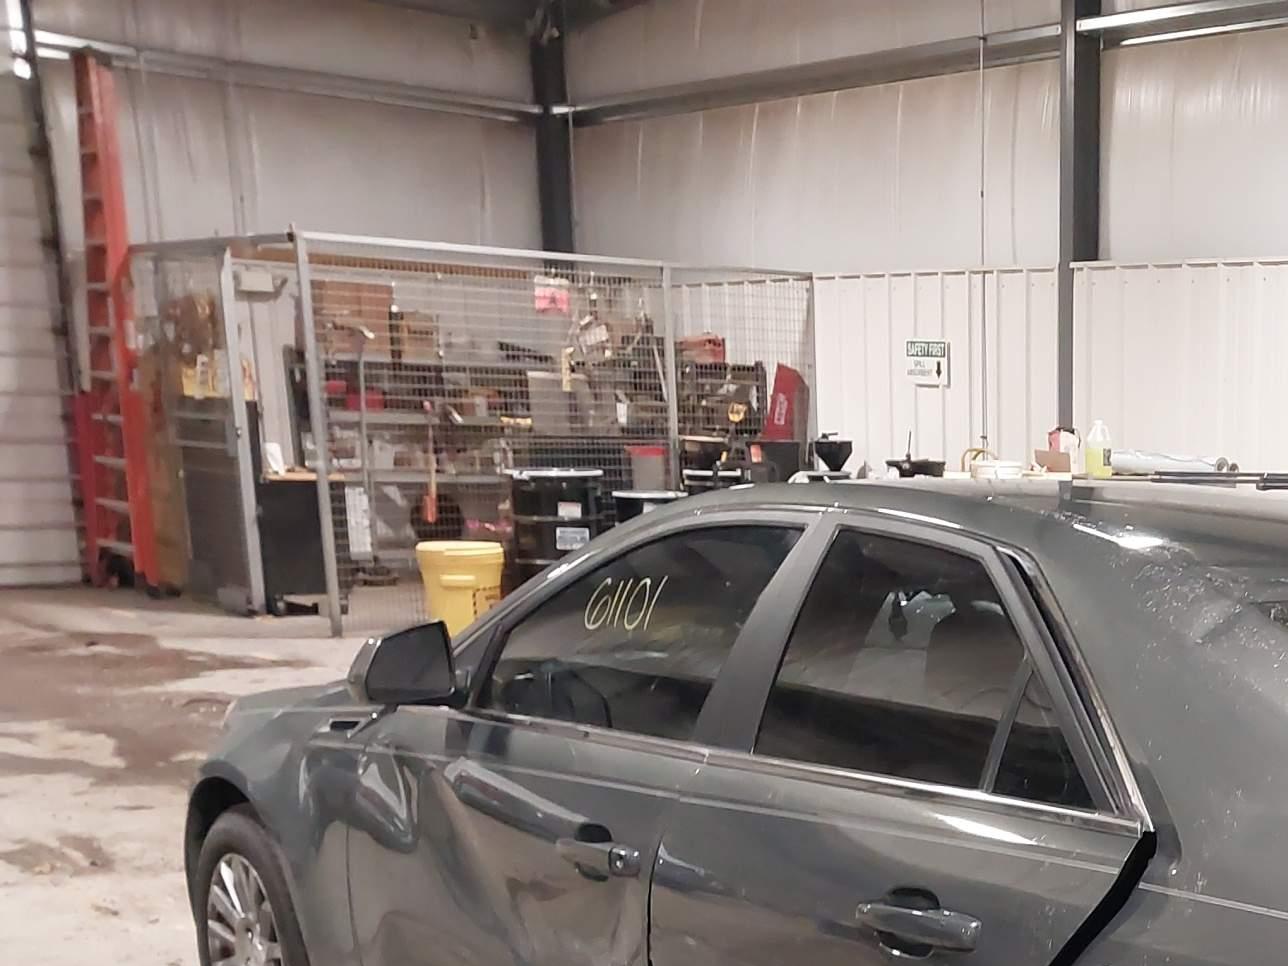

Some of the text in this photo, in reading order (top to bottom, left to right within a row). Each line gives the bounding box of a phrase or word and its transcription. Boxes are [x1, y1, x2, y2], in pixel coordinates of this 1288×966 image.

[908, 343, 945, 357] SAFETY FIRST
[584, 575, 669, 631] 61101
